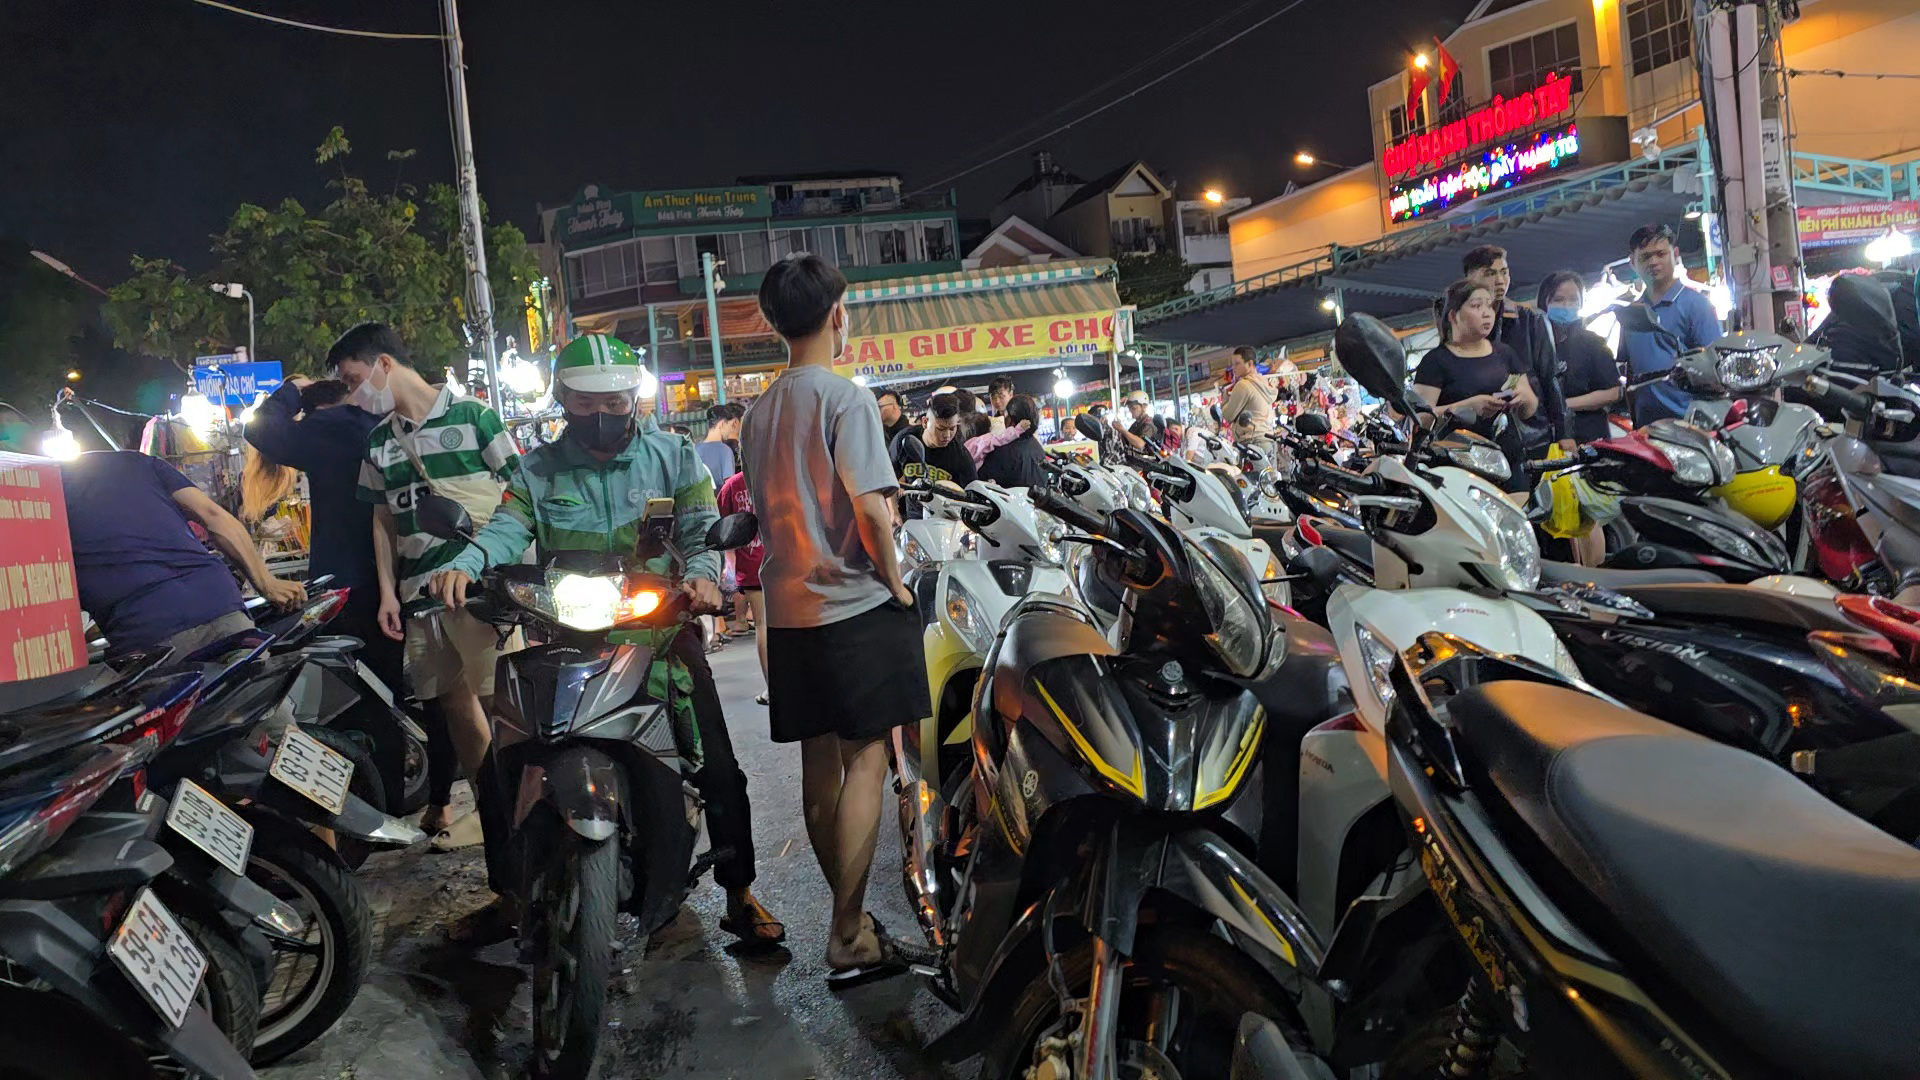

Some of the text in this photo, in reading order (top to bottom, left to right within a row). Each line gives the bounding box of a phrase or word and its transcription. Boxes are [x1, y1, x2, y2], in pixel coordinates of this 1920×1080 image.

[908, 326, 976, 358] GIỮ
[987, 324, 1036, 350] XE
[1601, 630, 1709, 660] VISION
[279, 736, 317, 783] 83-P1
[309, 751, 349, 808] 611.92
[209, 811, 247, 866] 123.40
[152, 934, 201, 1021] 211.36
